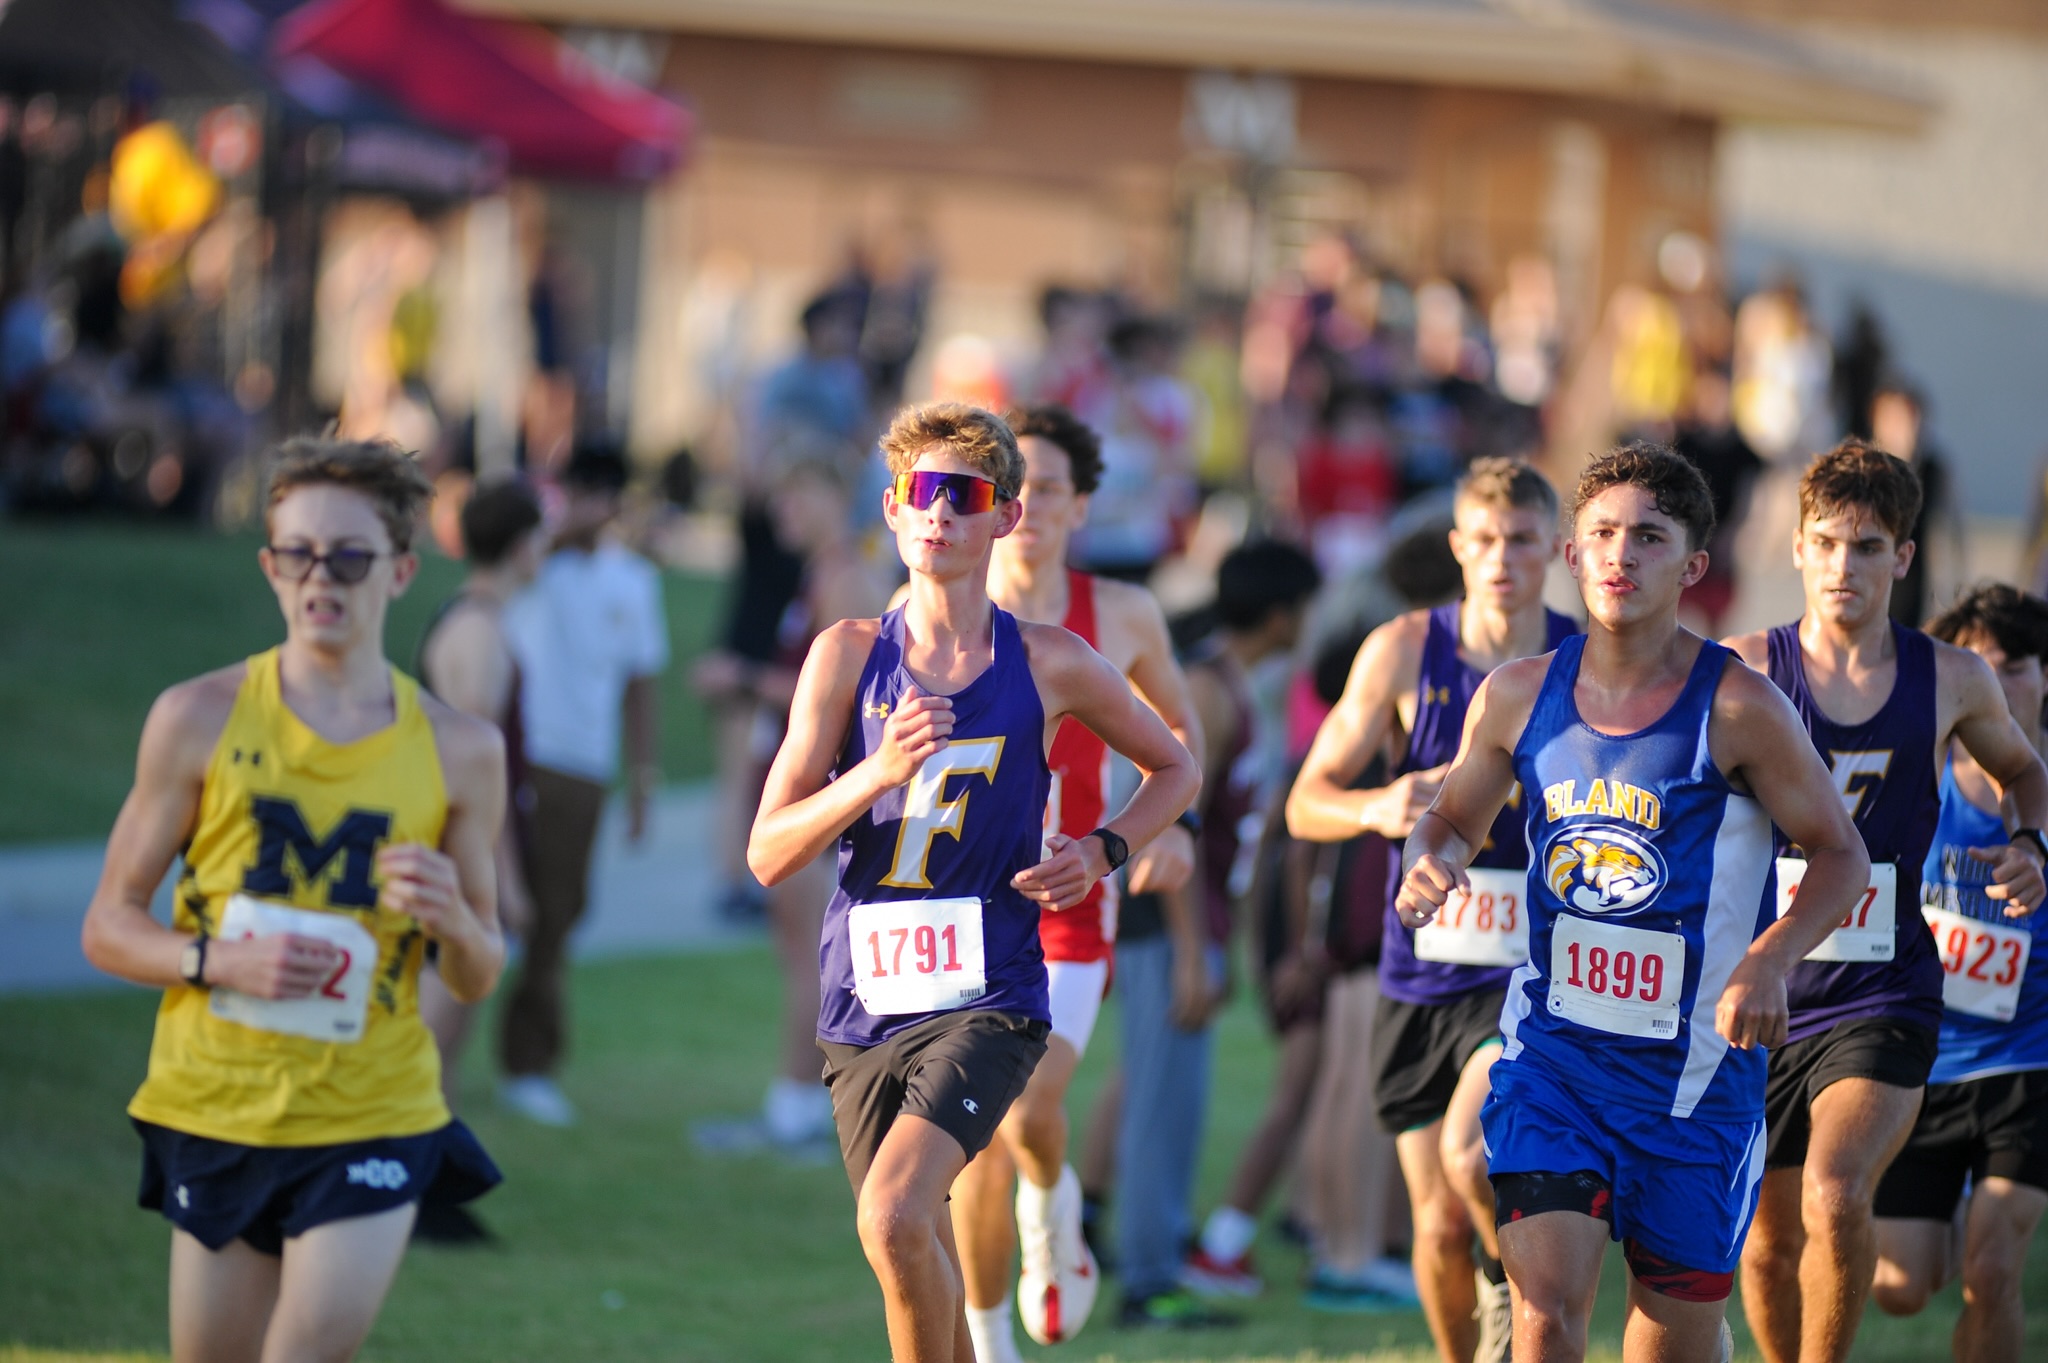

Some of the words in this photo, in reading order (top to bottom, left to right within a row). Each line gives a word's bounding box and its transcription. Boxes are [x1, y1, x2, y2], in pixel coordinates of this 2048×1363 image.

[877, 736, 1006, 889] F
[1542, 778, 1661, 830] BLAND
[241, 795, 393, 909] M
[867, 923, 962, 977] 1791
[1566, 941, 1664, 1002] 1899
